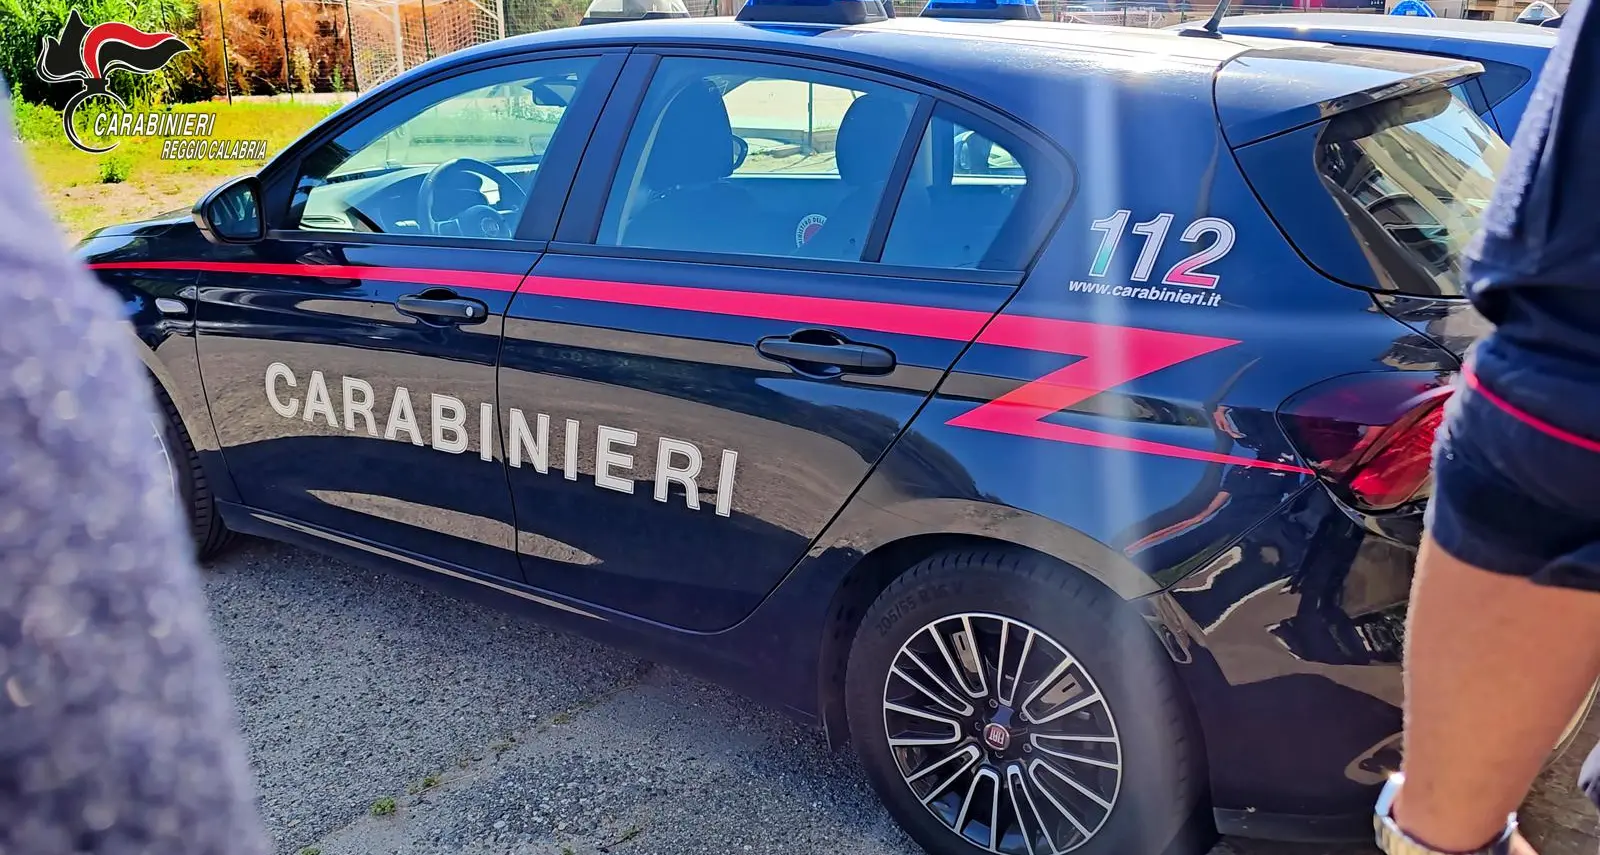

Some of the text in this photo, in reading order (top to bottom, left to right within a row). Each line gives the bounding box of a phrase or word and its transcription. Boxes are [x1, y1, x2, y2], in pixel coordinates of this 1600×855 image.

[1088, 210, 1236, 289] 112
[1068, 280, 1222, 307] www.carabinieri.it
[264, 361, 738, 518] CARABINIERI
[988, 727, 1005, 745] FIAT
